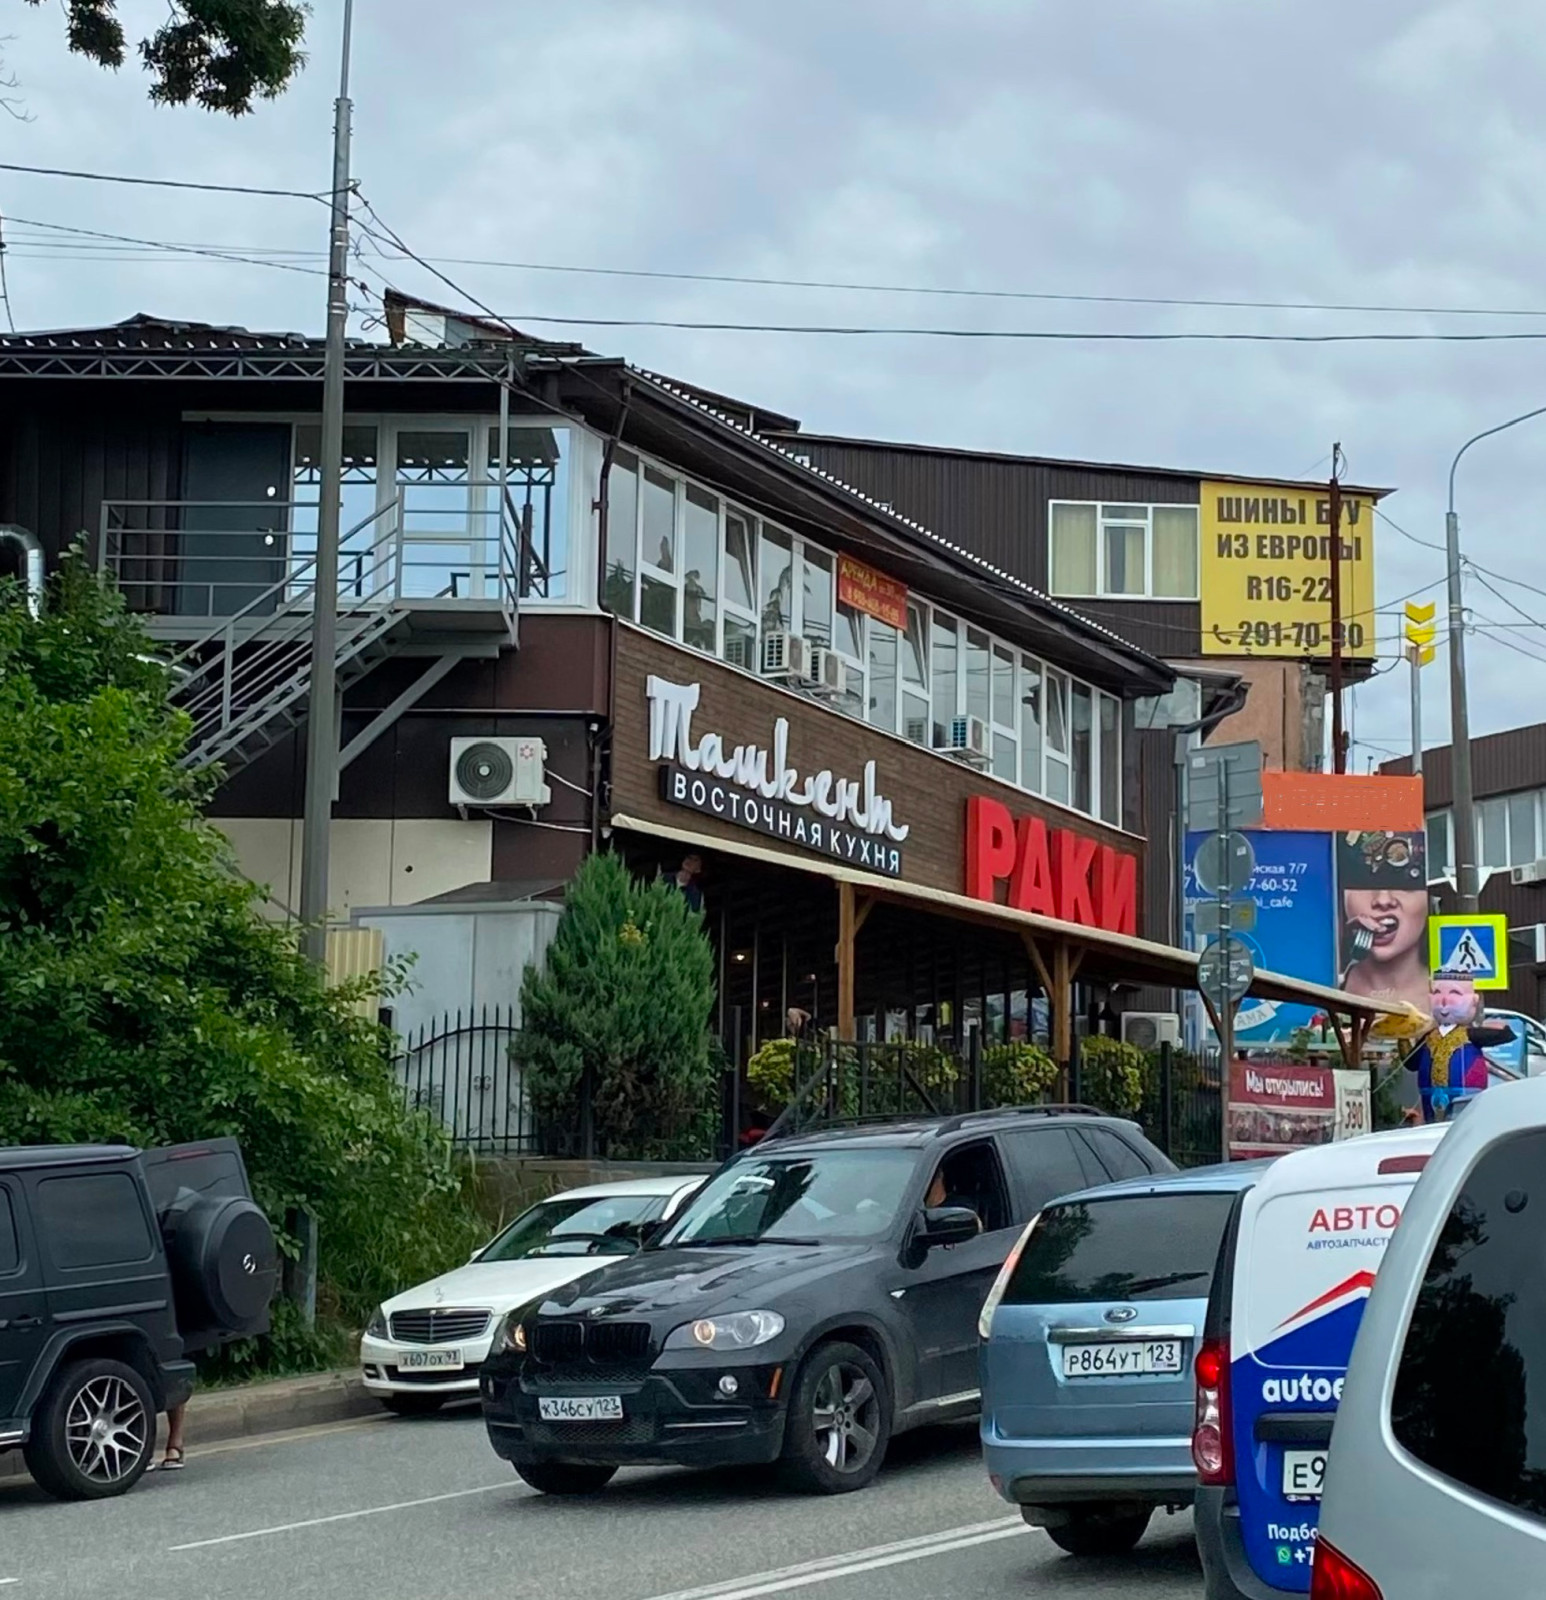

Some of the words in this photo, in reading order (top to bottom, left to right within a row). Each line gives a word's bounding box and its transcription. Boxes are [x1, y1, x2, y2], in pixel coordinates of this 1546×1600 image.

[1216, 496, 1306, 525] ШИНЫ
[1216, 533, 1249, 558] ИЗ
[1256, 535, 1362, 561] ЕВРОПЫ
[1247, 575, 1333, 602] R16-22
[646, 674, 909, 841] Ташкент
[673, 772, 823, 848] ВОСТОЧНАЯ
[830, 828, 900, 874] КУХНЯ
[966, 794, 1137, 937] РАКИ
[1289, 863, 1307, 874] 7/7
[1243, 878, 1298, 892] 7-60-52
[1246, 1069, 1264, 1094] Мы
[1264, 1075, 1324, 1102] открылись!
[1308, 1204, 1401, 1233] АВТО
[1069, 1347, 1142, 1372] Р864УТ
[1146, 1343, 1175, 1362] 123
